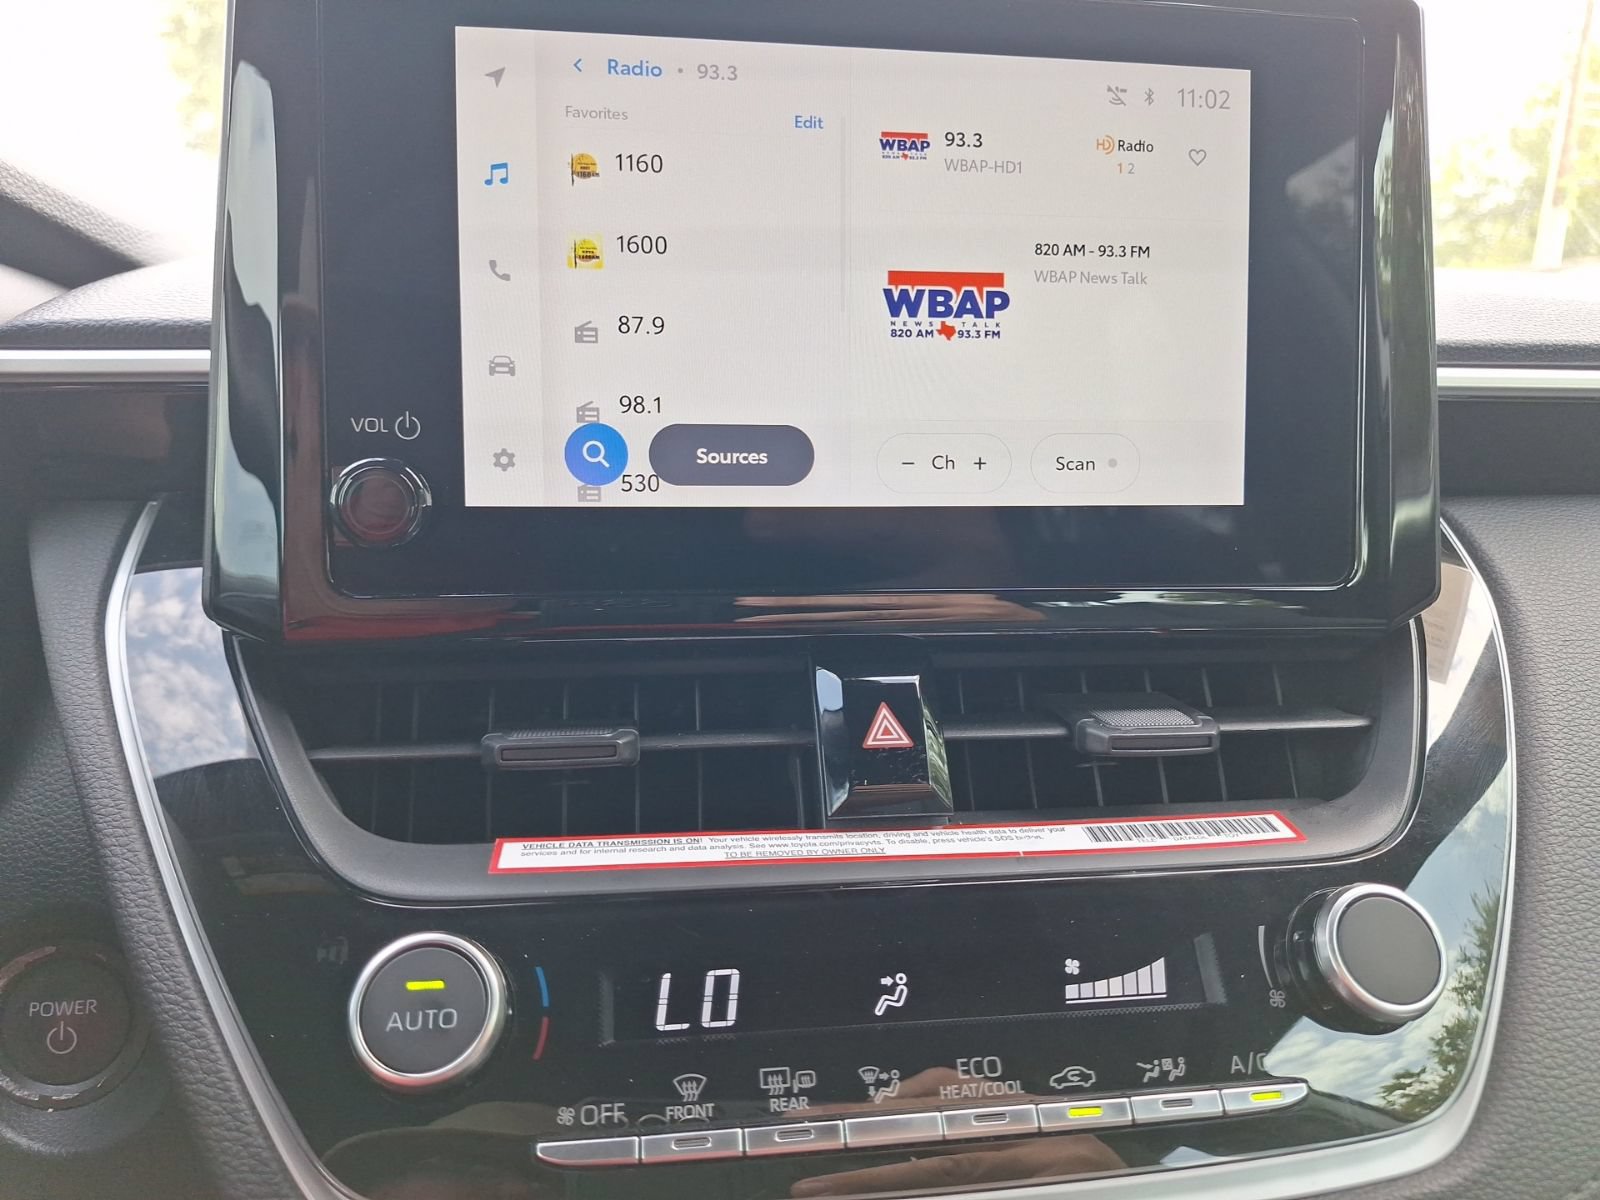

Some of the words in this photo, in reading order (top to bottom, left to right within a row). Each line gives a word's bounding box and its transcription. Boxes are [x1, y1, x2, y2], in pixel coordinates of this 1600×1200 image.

[607, 58, 663, 78] Radio
[697, 63, 738, 82] 93.3
[1177, 88, 1231, 110] 11:02
[565, 105, 629, 121] Favorites
[794, 115, 824, 130] Edit
[879, 138, 931, 152] WBAP
[944, 132, 983, 148] 93.3
[1118, 139, 1154, 153] Radio
[615, 153, 664, 174] 1160
[944, 158, 1023, 175] WBAP-HD1
[1117, 162, 1123, 174] 1
[1128, 162, 1135, 175] 2
[616, 235, 668, 255] 1600
[1034, 243, 1060, 257] 820
[1063, 243, 1086, 258] AM
[1098, 244, 1127, 258] 93.3
[1130, 245, 1151, 259] FM
[1034, 269, 1078, 285] WBAP
[1079, 271, 1118, 285] News
[1121, 272, 1148, 286] Talk
[883, 288, 1010, 319] WBAP
[617, 315, 665, 336] 87.9
[890, 329, 912, 338] 820
[916, 329, 934, 338] AM
[957, 329, 981, 339] 93.3
[985, 330, 1001, 339] FM
[618, 394, 663, 415] 98.1
[350, 418, 389, 432] VOL
[696, 447, 768, 465] Sources
[931, 454, 956, 470] Ch
[1055, 456, 1096, 471] Scan
[620, 473, 660, 493] 530
[568, 841, 594, 849] DATA
[597, 838, 671, 848] TRANSMISSION
[673, 838, 683, 846] IS
[762, 835, 803, 843] wirelessly
[805, 833, 845, 841] transmits
[883, 831, 911, 839] driving
[593, 847, 627, 855] internal
[629, 846, 667, 854] research
[709, 843, 747, 851] analysis.
[725, 851, 738, 859] TO
[740, 850, 753, 858] BE
[755, 848, 805, 858] REMOVED
[806, 847, 820, 856] BY
[821, 846, 859, 856] OWNER
[860, 846, 886, 855] ONLY
[29, 999, 97, 1017] POWER
[385, 1007, 458, 1032] AUTO
[956, 1055, 1001, 1079] ECO
[939, 1079, 1025, 1101] HEAT/COOL
[666, 1102, 715, 1121] FRONT
[769, 1096, 810, 1113] REAR
[580, 1103, 626, 1126] OFF
